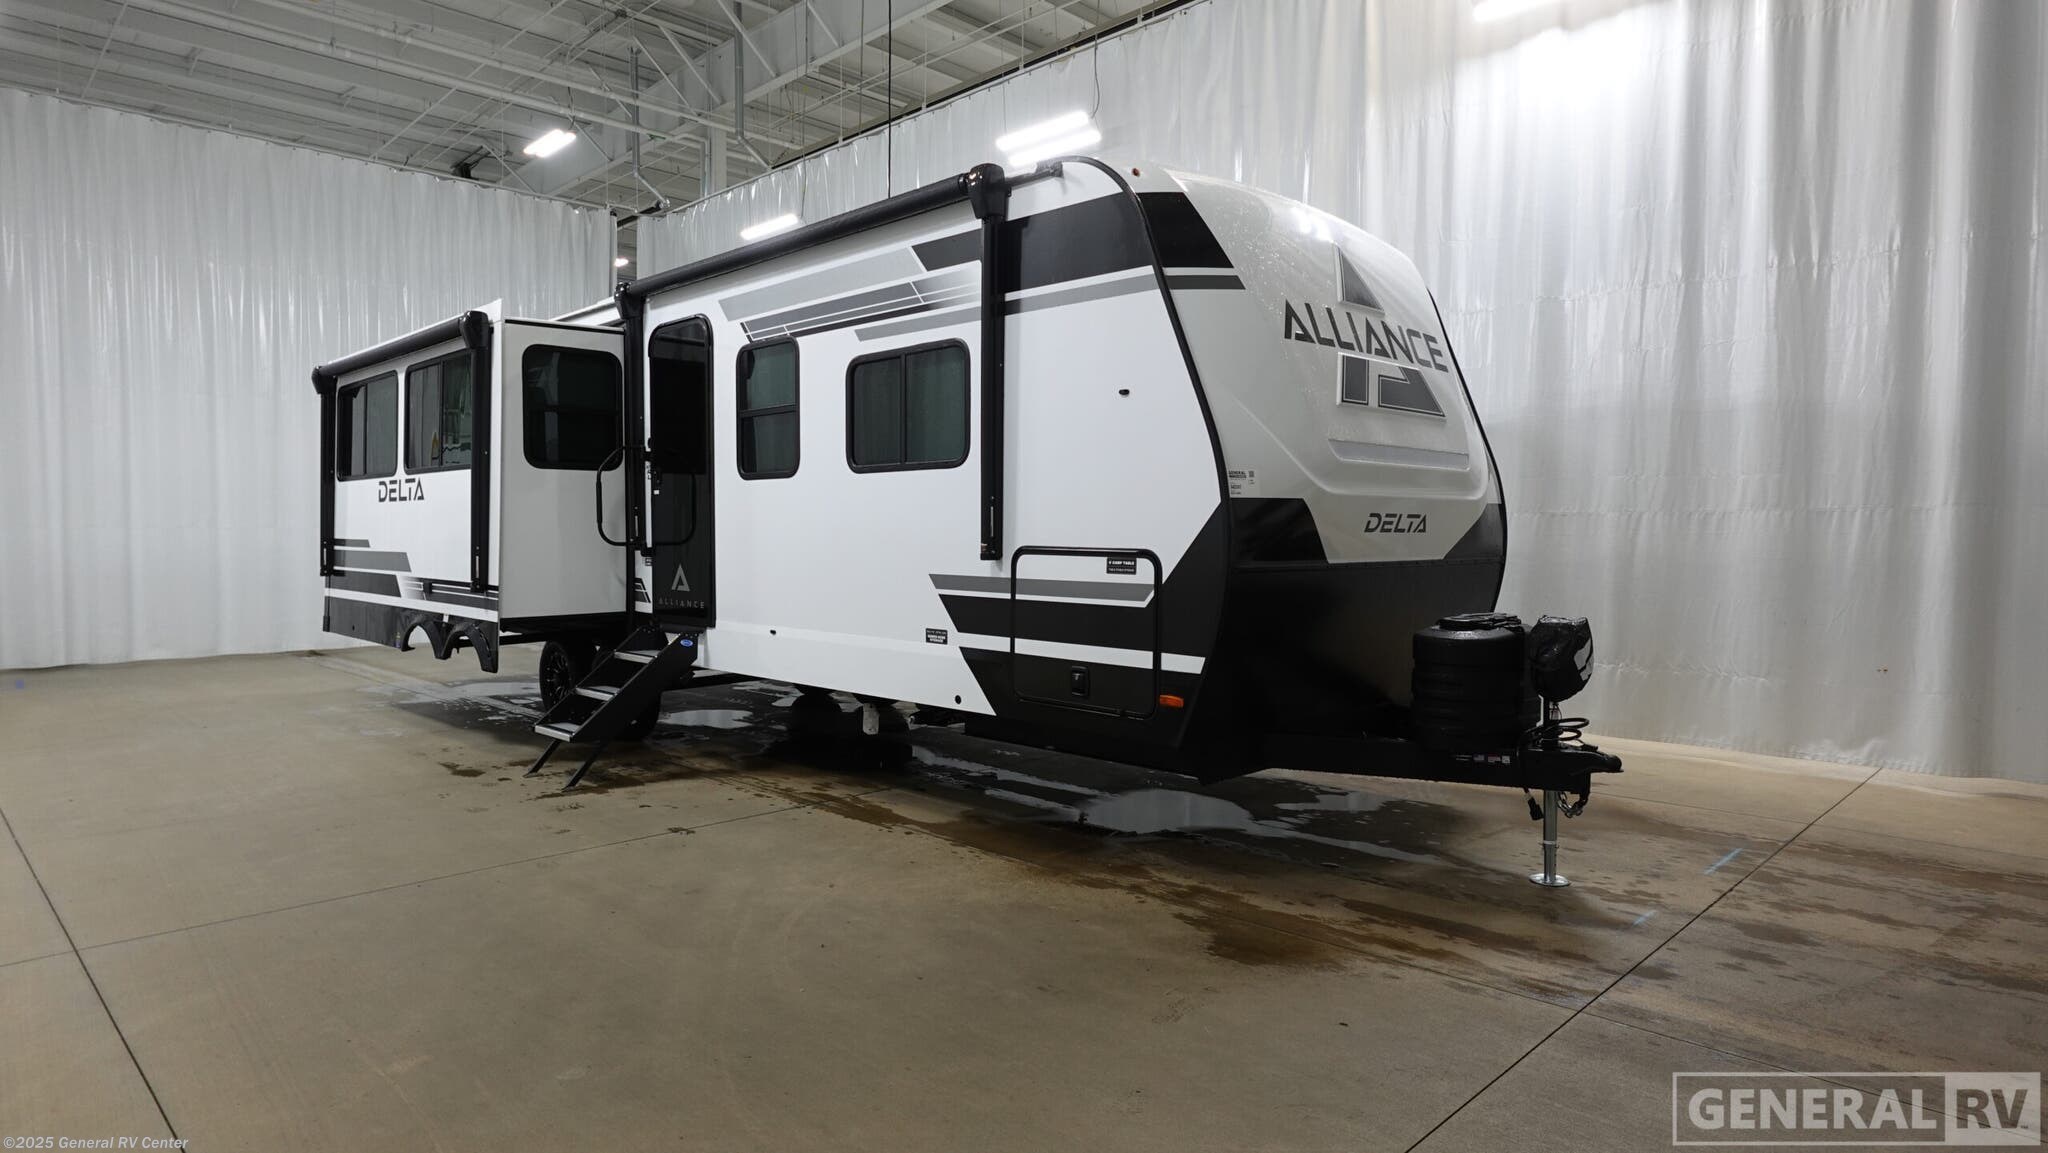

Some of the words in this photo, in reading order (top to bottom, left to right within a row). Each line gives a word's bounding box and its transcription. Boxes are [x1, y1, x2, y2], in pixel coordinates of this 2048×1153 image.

[1284, 299, 1449, 373] ALLIANCE
[378, 477, 425, 502] DELTA
[1364, 512, 1427, 533] DELTA
[658, 597, 705, 609] ALLIANCE
